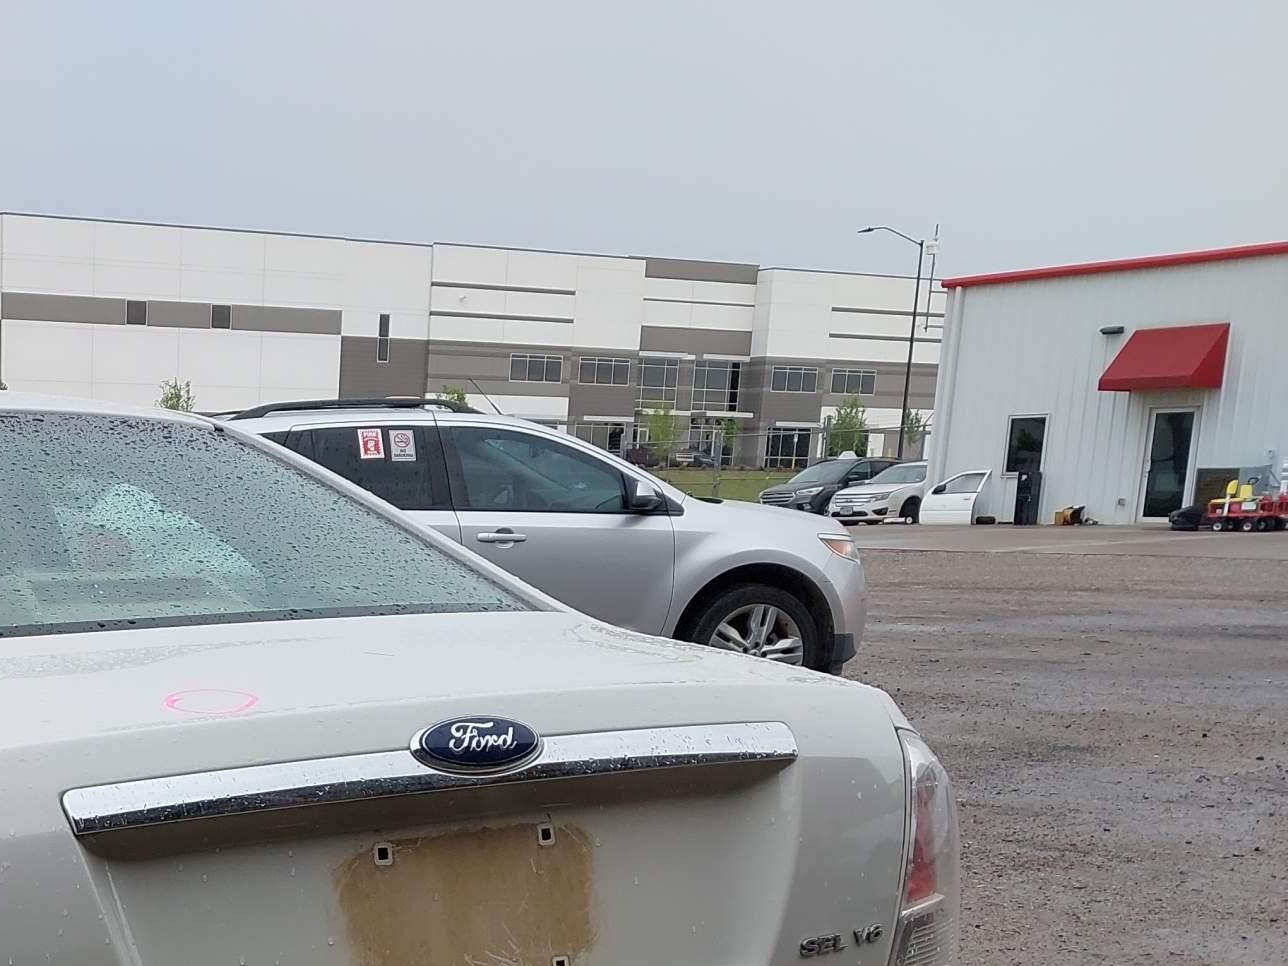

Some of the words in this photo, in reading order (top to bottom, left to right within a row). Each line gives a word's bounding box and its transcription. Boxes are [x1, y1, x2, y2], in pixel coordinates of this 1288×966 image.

[449, 721, 517, 752] Ford
[799, 933, 848, 958] SEL
[853, 923, 882, 946] V6
